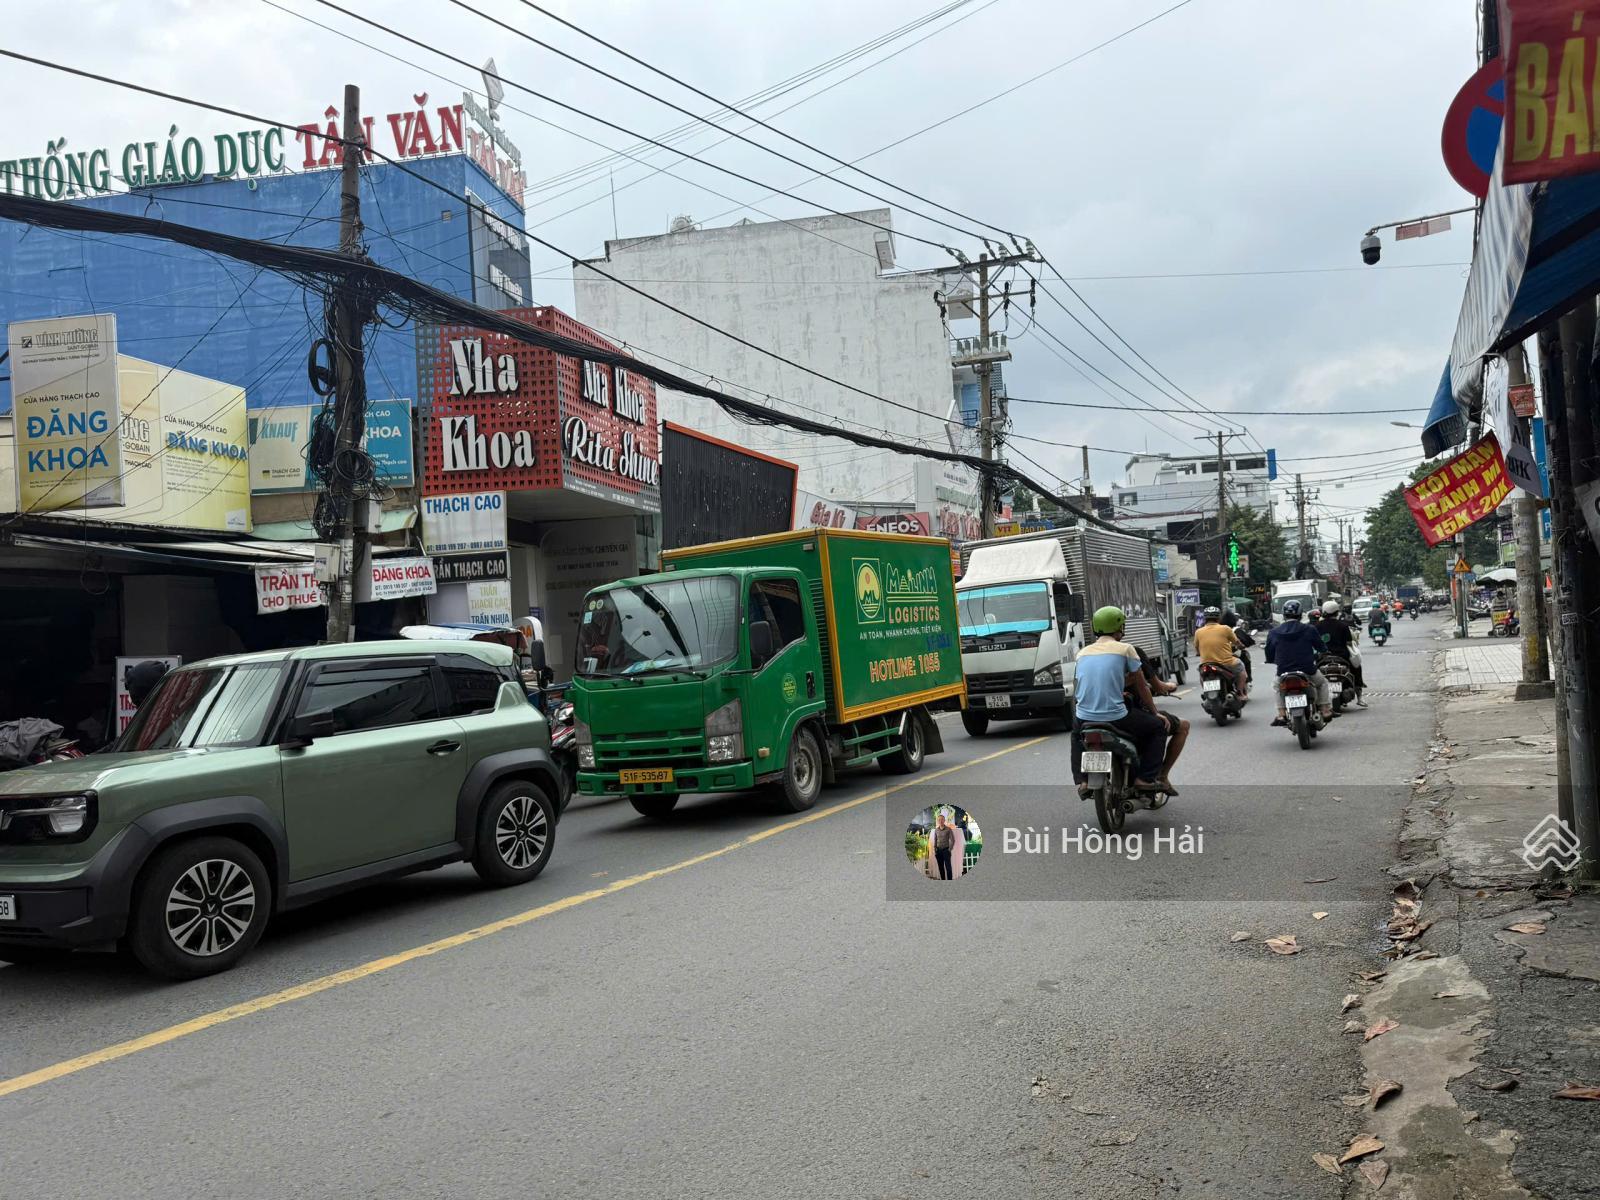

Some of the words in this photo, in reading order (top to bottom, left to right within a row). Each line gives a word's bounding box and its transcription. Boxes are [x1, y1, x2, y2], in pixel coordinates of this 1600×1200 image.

[1512, 10, 1600, 162] BÁ
[0, 136, 111, 200] THỐNG
[122, 124, 205, 188] GIÁO
[214, 127, 286, 191] DỤC
[295, 105, 375, 169] TÂN
[387, 92, 464, 158] VĂN
[449, 336, 518, 397] Nha
[24, 395, 38, 404] CỬA
[39, 394, 59, 403] HÀNG
[61, 392, 84, 402] THẠCH
[85, 391, 100, 399] CAO
[583, 359, 609, 408] Nha
[614, 366, 646, 424] Khoa
[27, 407, 109, 438] ĐĂNG
[164, 414, 177, 423] CỬA
[178, 417, 196, 428] HÀNG
[215, 426, 228, 434] CAO
[375, 409, 391, 417] CAO
[261, 416, 299, 443] KNAUF
[165, 430, 209, 454] ĐĂNG
[210, 440, 248, 461] KHOA
[440, 414, 536, 472] Khoa
[564, 416, 616, 472] Rita
[620, 431, 659, 486] Shine
[28, 445, 109, 472] KHOA
[1415, 470, 1451, 500] XÔI
[424, 495, 470, 516] THẠCH
[474, 494, 502, 511] CAO
[1423, 479, 1480, 520] BÁNH
[866, 519, 920, 534] ENEOS
[261, 568, 300, 592] TRẦN
[373, 565, 404, 582] ĐĂNG
[405, 565, 431, 580] KHOA
[453, 561, 484, 580] THẠCH
[486, 559, 505, 575] CAO
[262, 595, 285, 608] CHO
[287, 590, 318, 605] THUÊ
[490, 612, 510, 626] NHỰA
[888, 606, 940, 624] LOGISTICS
[859, 631, 868, 640] AN
[978, 643, 1007, 652] ISUZU
[869, 656, 917, 683] HOTLINE:
